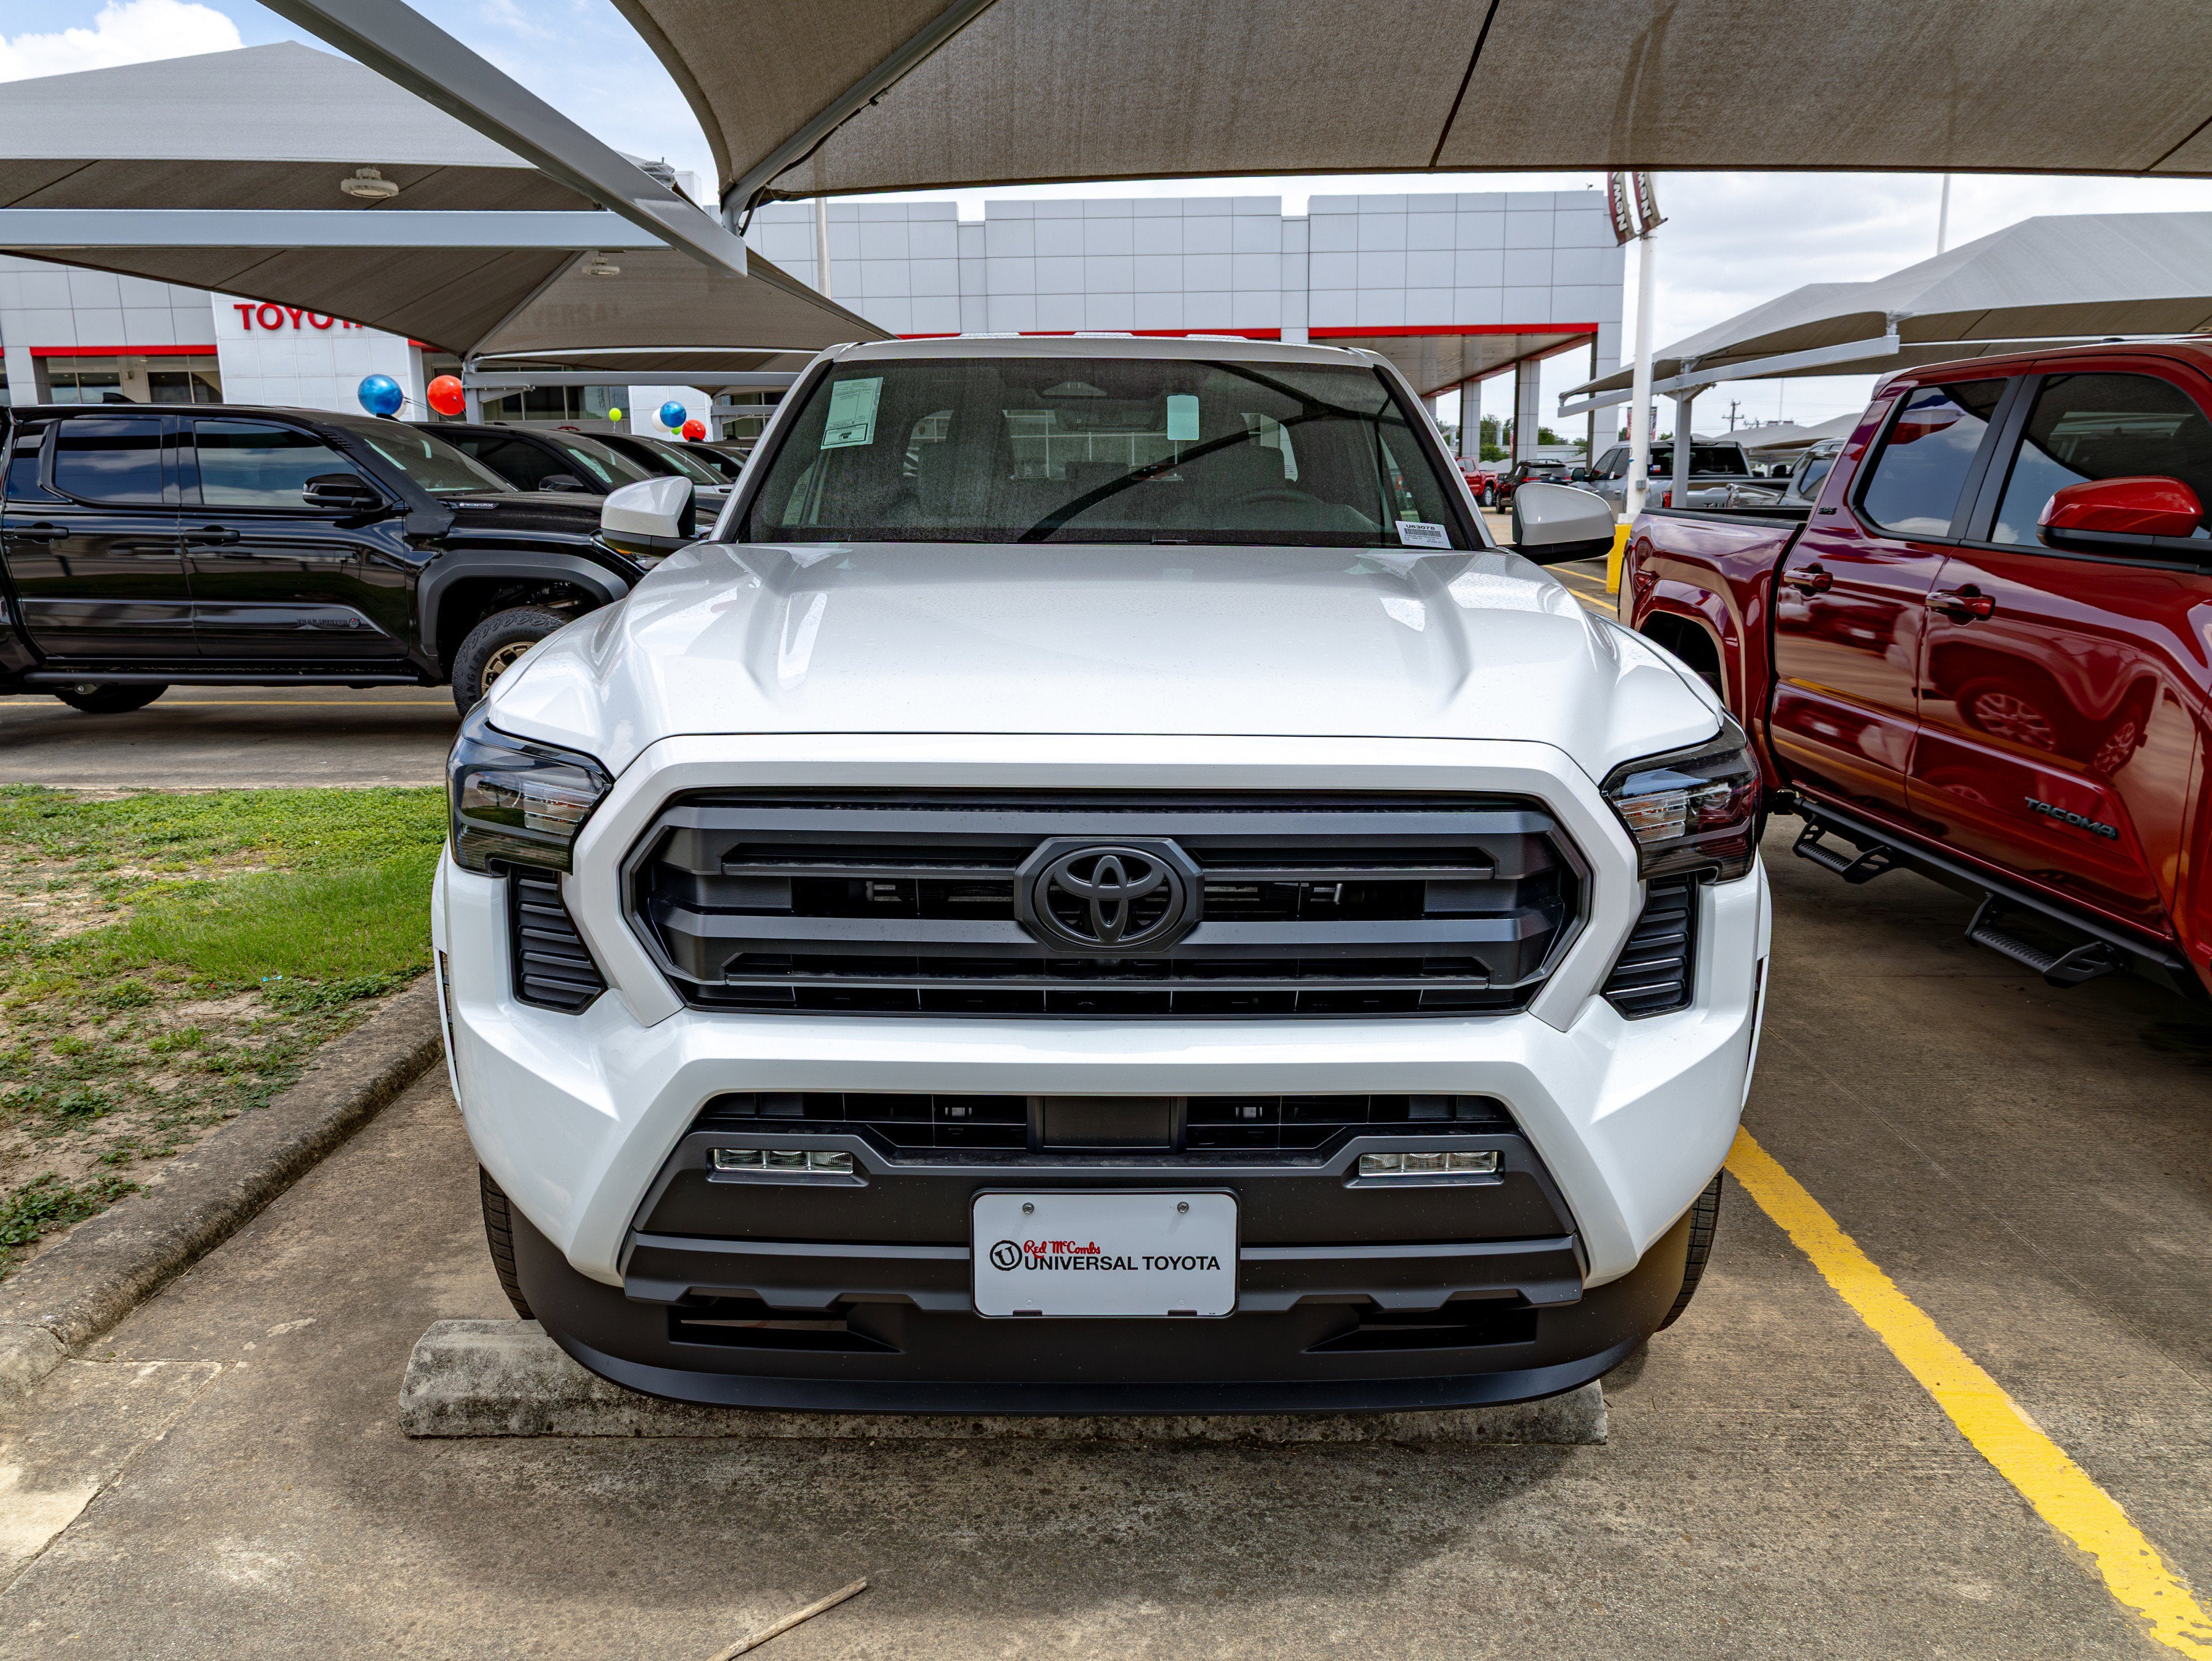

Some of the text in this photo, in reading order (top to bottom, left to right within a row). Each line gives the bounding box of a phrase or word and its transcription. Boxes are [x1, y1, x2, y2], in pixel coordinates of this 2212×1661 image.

[1613, 184, 1628, 232] New
[233, 302, 363, 330] TOYO
[2024, 796, 2119, 841] TACOMA
[1024, 1240, 1047, 1259] Red
[1025, 1255, 1221, 1270] UNIVERSAL TOYOTA
